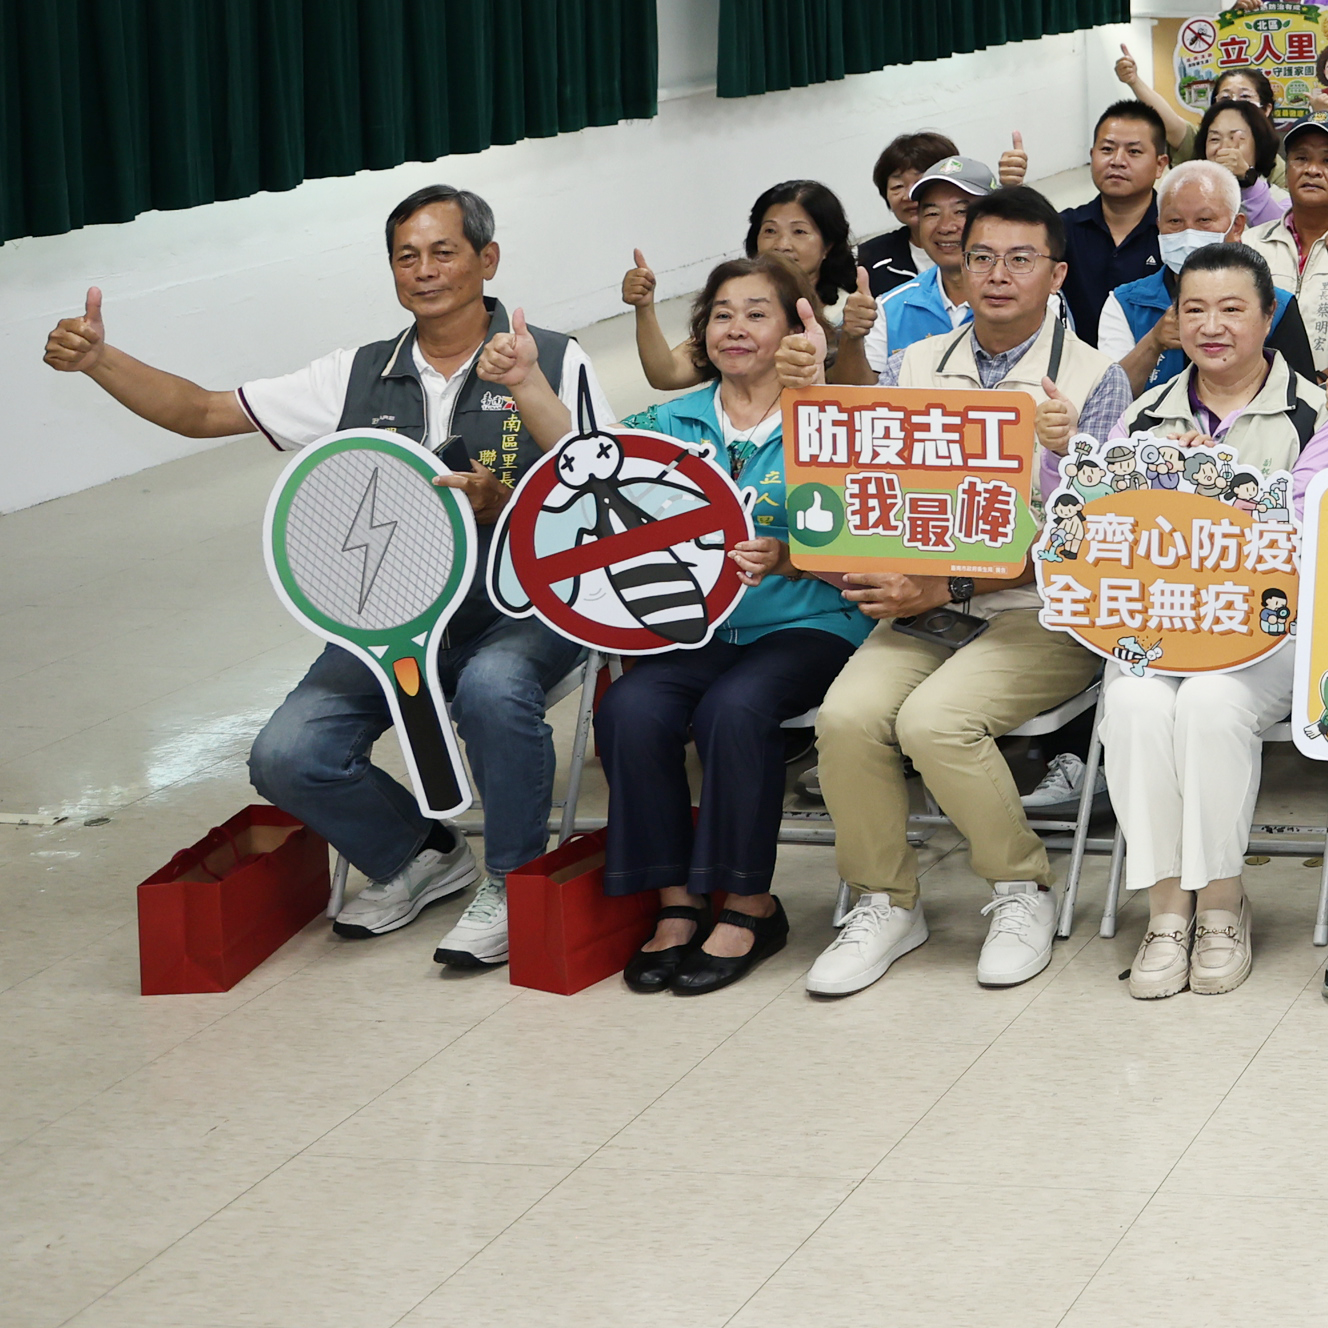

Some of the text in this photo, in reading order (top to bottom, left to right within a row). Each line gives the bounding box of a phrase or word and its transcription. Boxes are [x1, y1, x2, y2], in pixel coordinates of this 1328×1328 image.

[1218, 30, 1319, 68] 立人里
[1257, 19, 1279, 31] 北區
[1272, 65, 1315, 78] 守護家園
[499, 413, 522, 490] 南區里長
[796, 403, 1020, 469] 防疫志工
[846, 473, 1016, 552] 我最棒
[1084, 513, 1295, 574] 齊心防疫
[1043, 574, 1251, 635] 全民無疫
